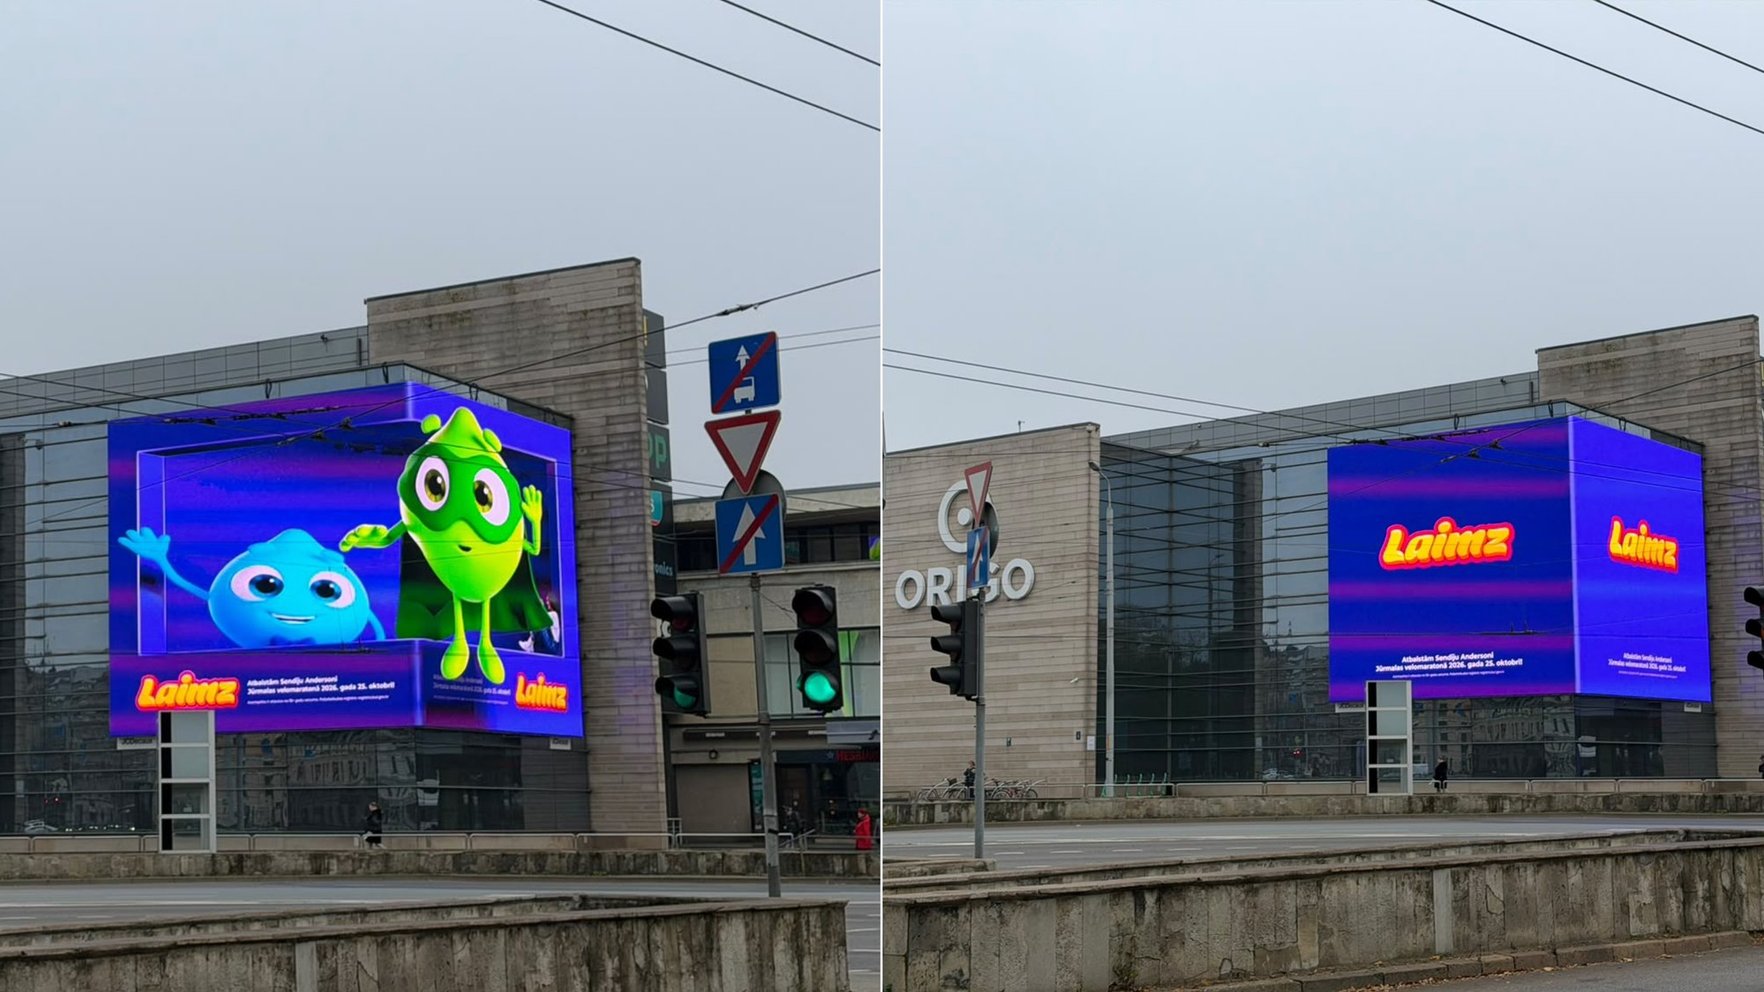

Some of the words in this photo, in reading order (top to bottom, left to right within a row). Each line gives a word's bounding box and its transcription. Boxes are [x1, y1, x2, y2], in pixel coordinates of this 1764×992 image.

[1381, 518, 1513, 568] Laimz
[1609, 517, 1678, 572] Laimz
[136, 671, 240, 710] Laimz
[515, 673, 567, 711] Laimz
